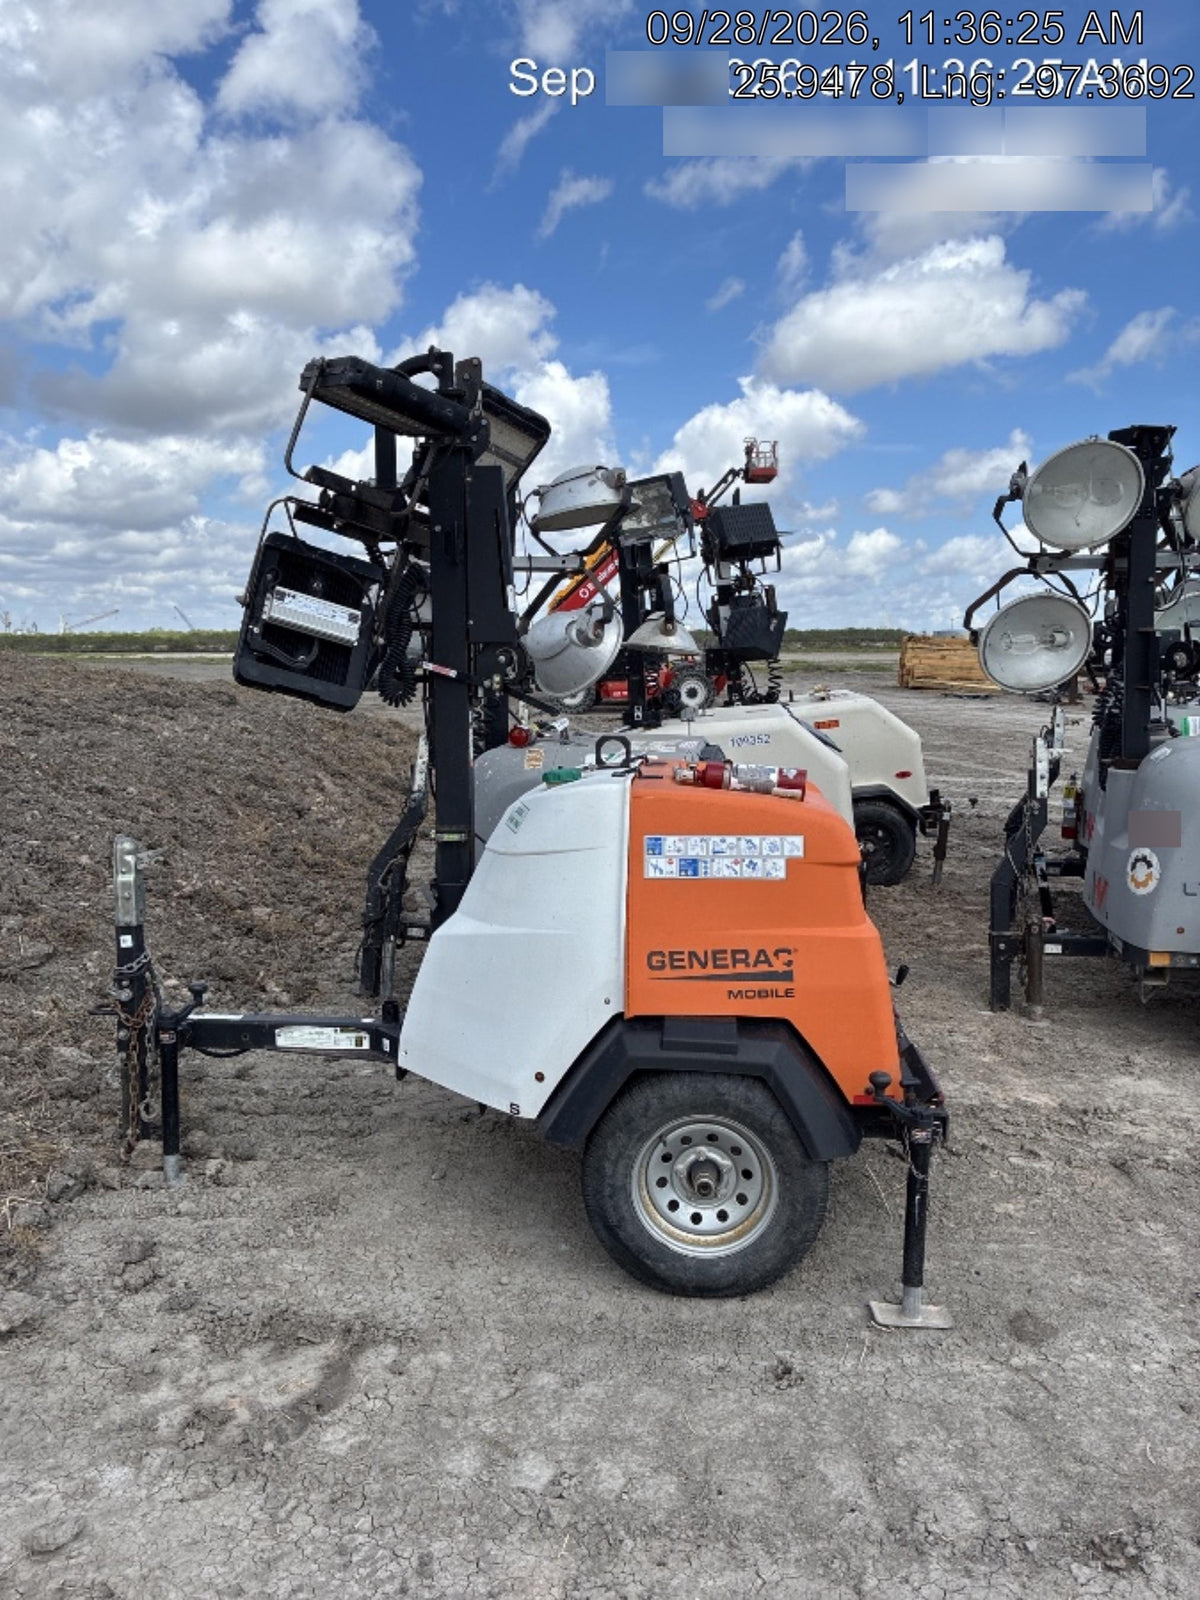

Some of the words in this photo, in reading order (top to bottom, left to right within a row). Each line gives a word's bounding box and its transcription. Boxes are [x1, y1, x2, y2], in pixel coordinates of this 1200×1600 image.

[1183, 882, 1200, 897] L
[646, 947, 794, 971] GENERAC
[727, 987, 796, 1000] MOBILE
